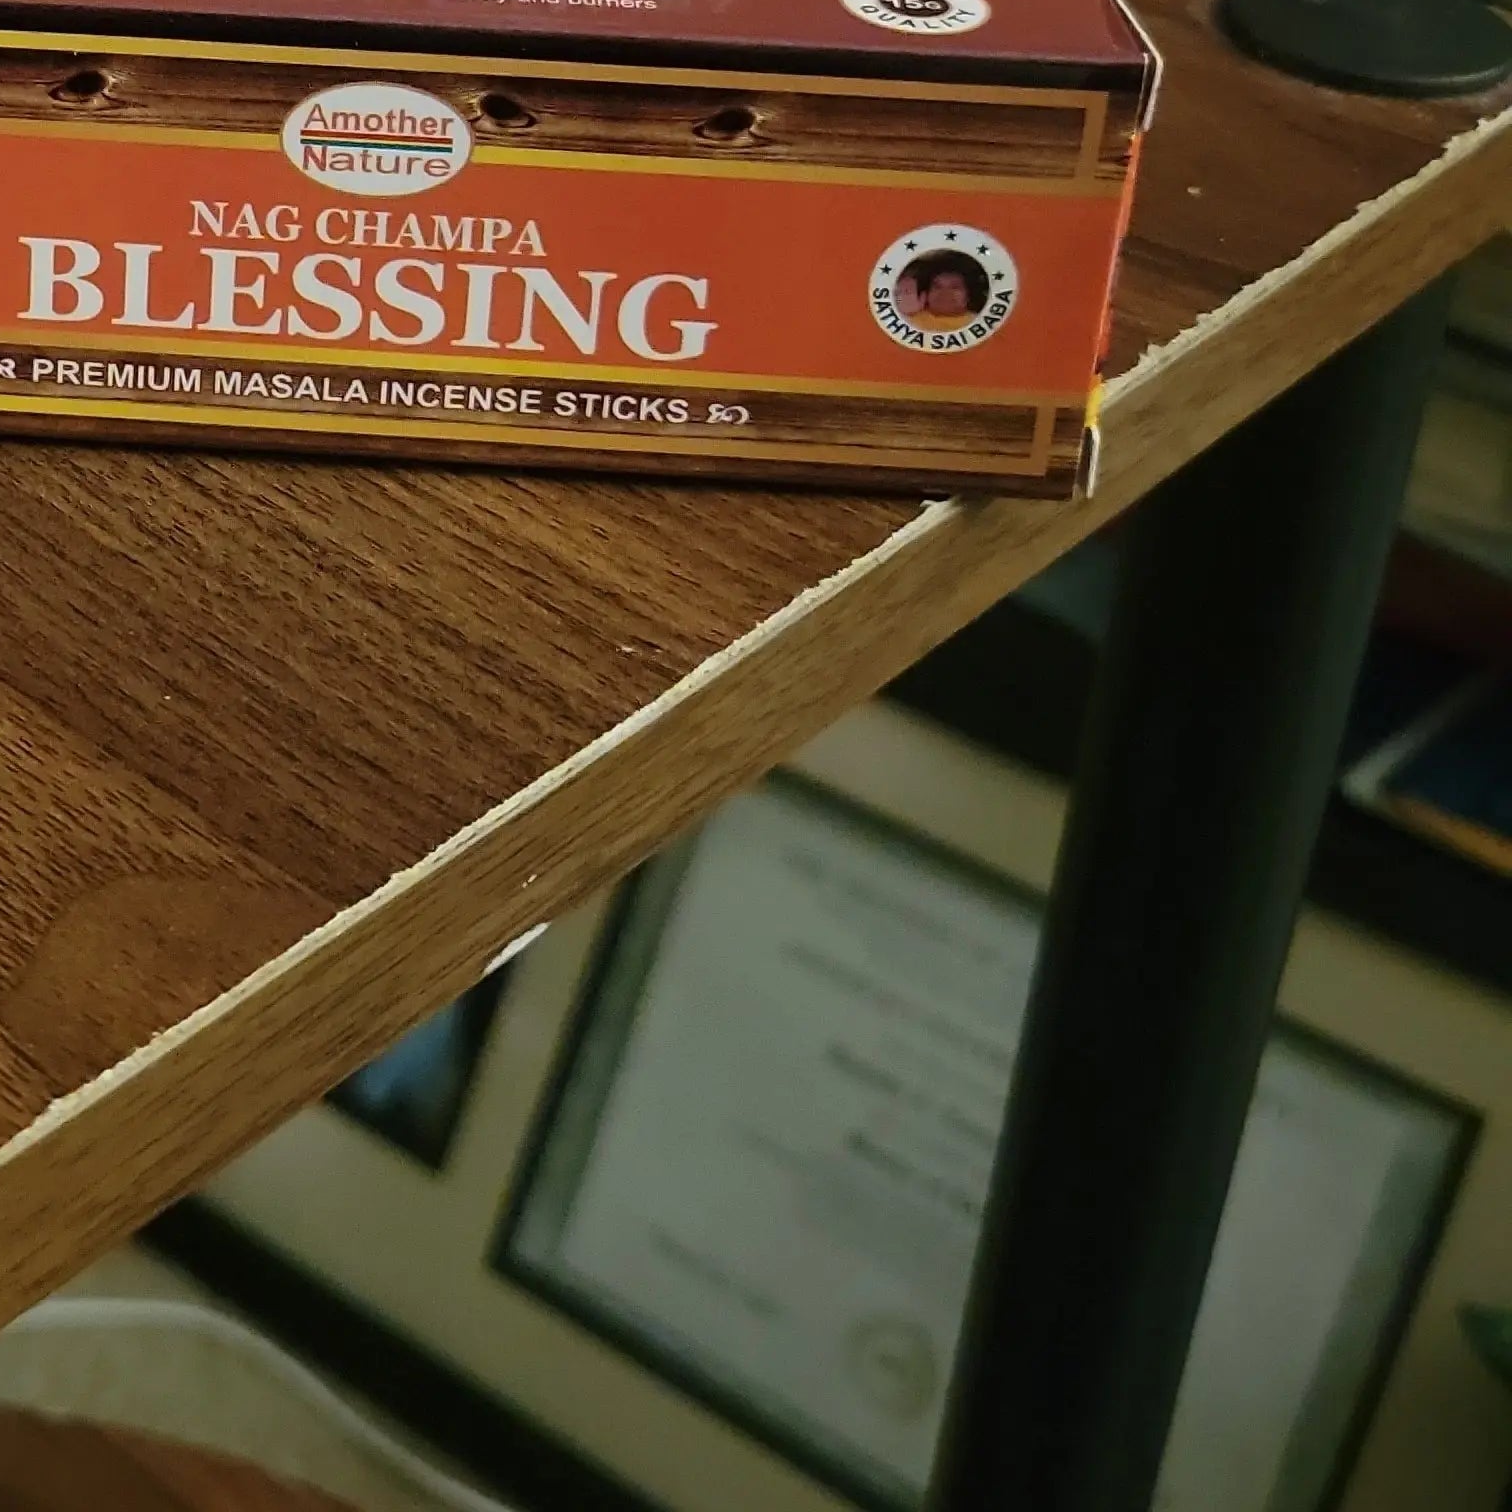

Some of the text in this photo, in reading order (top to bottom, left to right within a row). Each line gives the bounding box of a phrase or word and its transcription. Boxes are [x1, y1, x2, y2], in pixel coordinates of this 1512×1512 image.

[860, 5, 976, 29] QUALITY
[304, 103, 455, 137] Amother
[302, 145, 451, 177] Nature
[189, 200, 547, 257] NAG CHAMPA
[16, 235, 719, 362] BLESSING
[873, 287, 1014, 351] SATHYA SAI BABA
[31, 357, 689, 424] PREMIUM MASALA INCENSE STICKS
